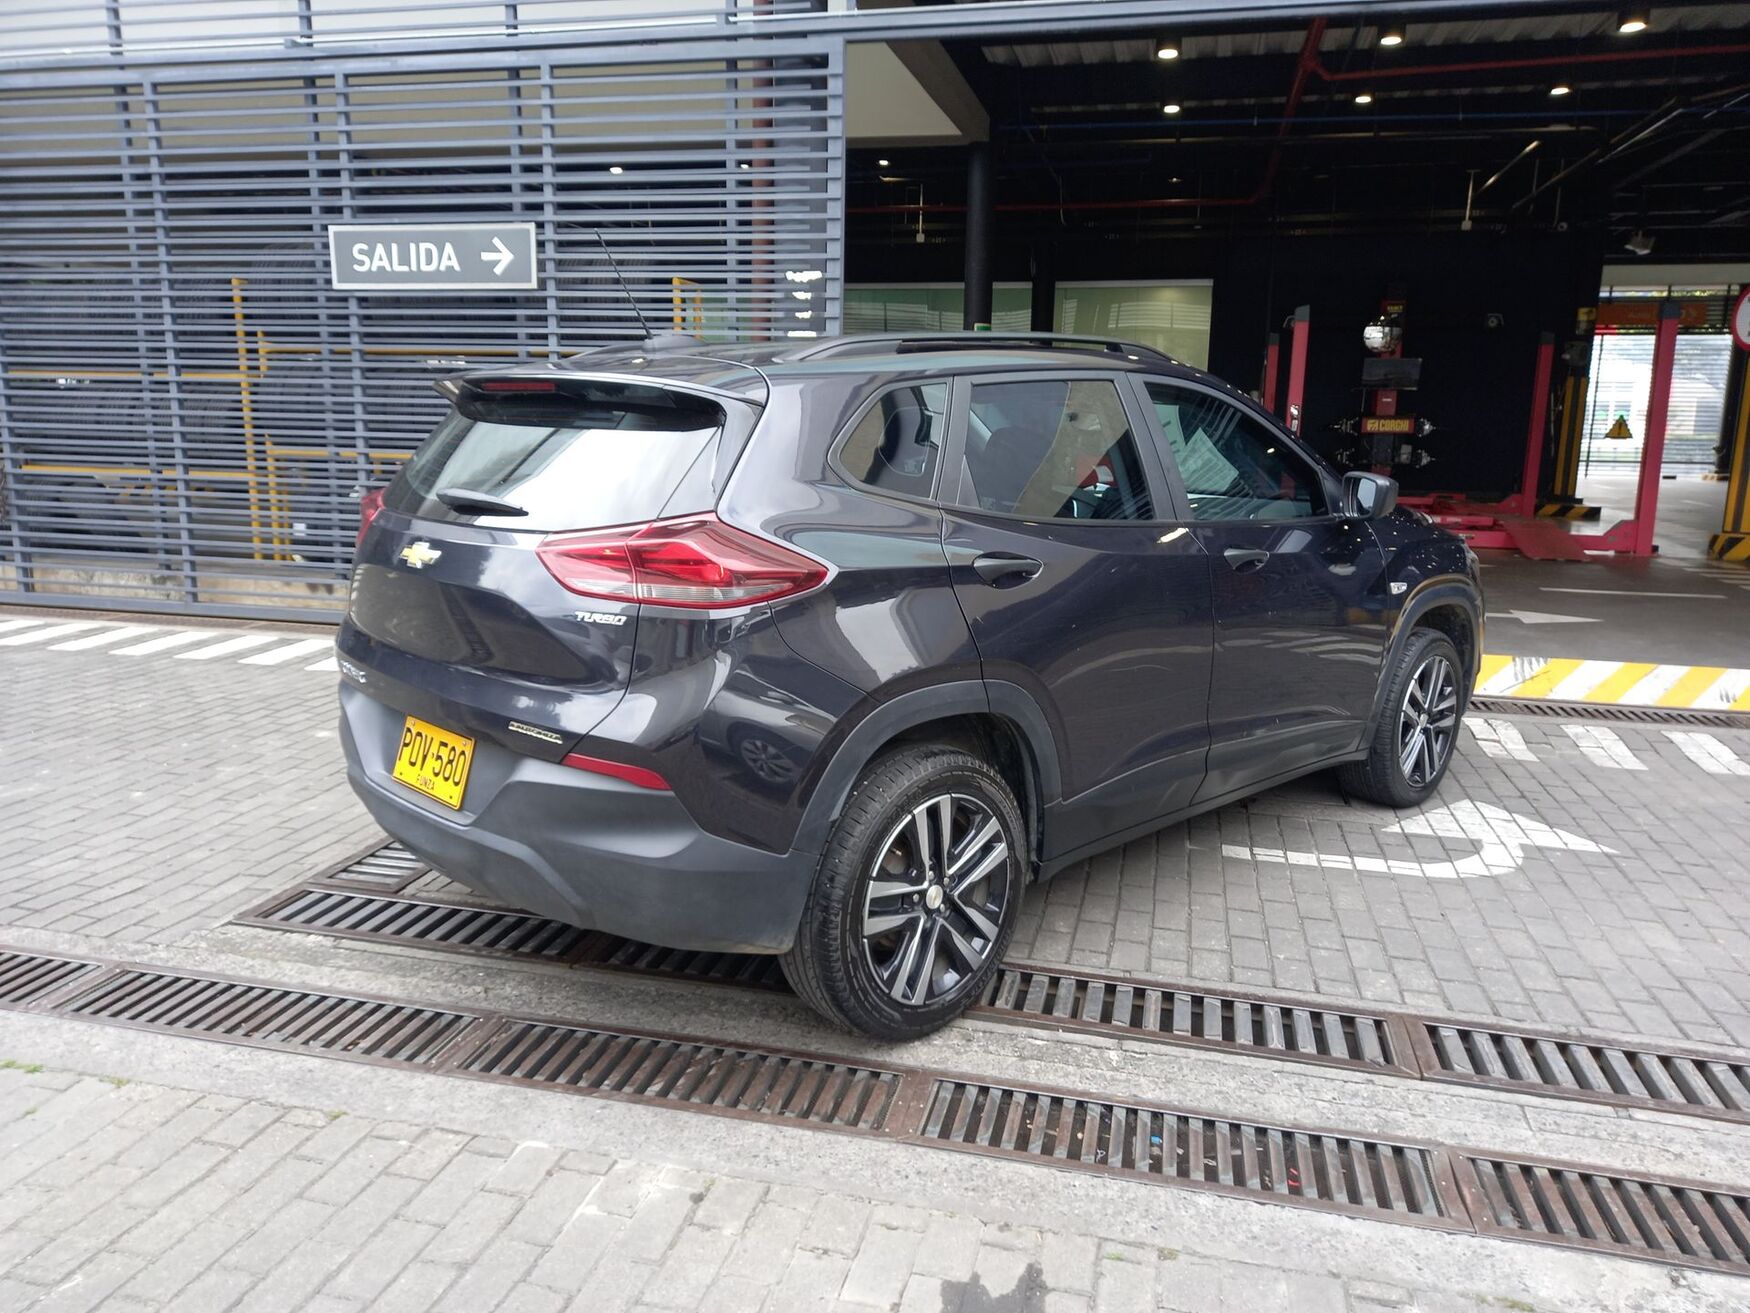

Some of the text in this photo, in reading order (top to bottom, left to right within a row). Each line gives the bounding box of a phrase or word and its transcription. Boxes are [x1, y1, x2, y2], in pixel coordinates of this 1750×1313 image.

[352, 242, 461, 272] SALIDA
[1379, 419, 1409, 432] CORGHI
[574, 611, 628, 626] TURBO
